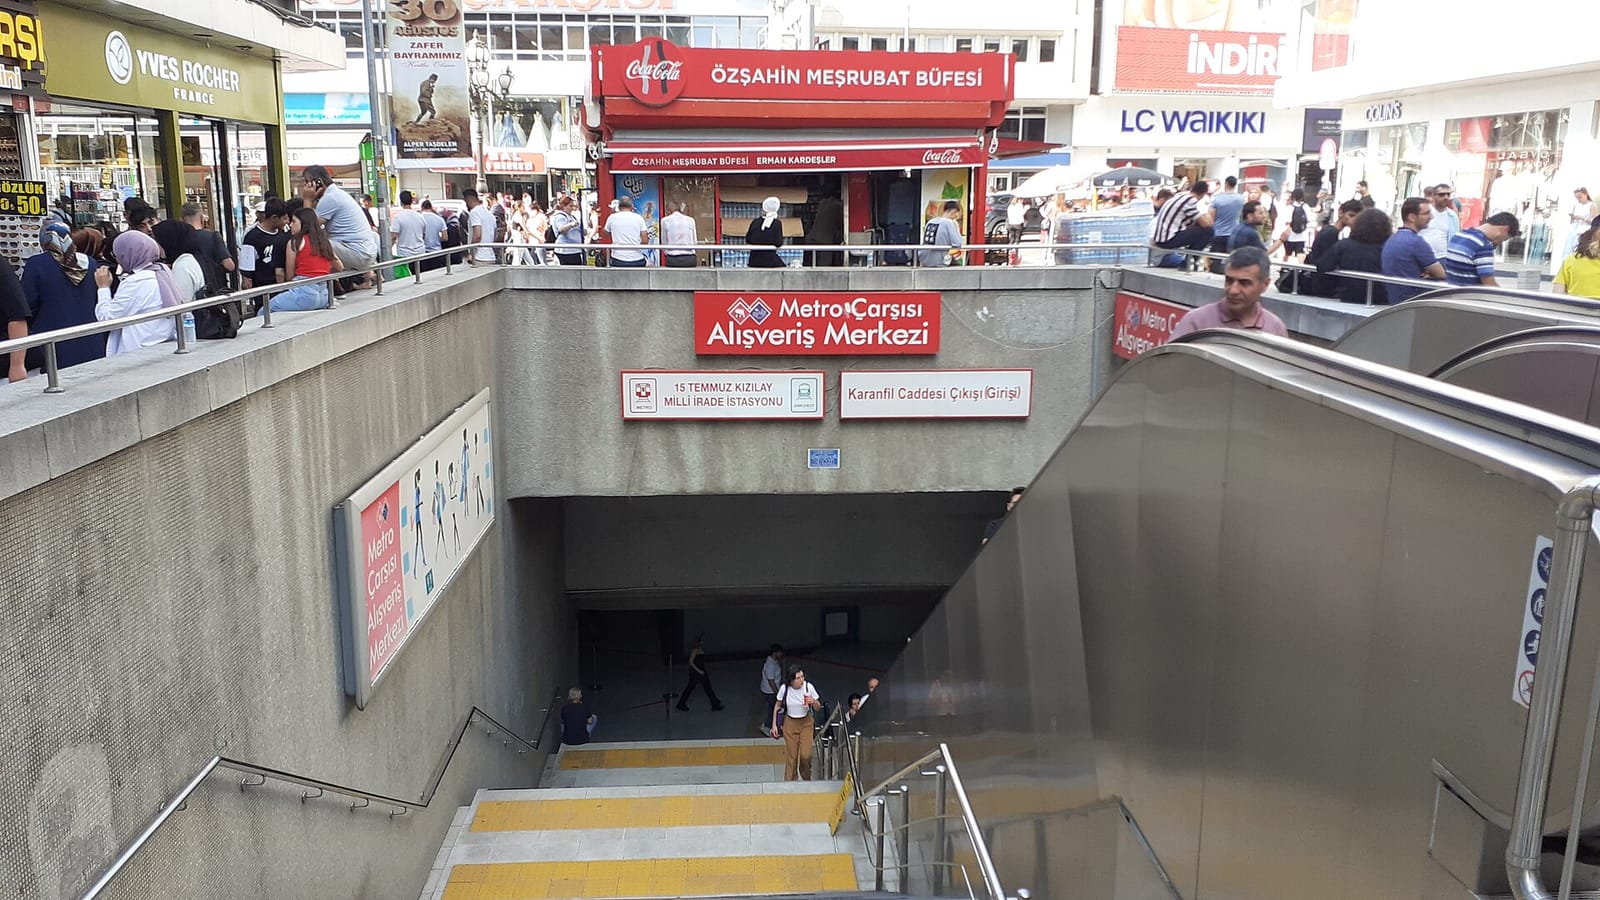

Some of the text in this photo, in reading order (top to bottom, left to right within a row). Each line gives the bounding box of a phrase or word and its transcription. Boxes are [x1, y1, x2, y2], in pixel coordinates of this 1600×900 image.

[389, 0, 458, 21] 30
[394, 25, 459, 37] AĞUSTOS
[136, 49, 240, 92] YVES ROCHER
[711, 64, 983, 88] ÖZŞAHİN MEŞRUBAT BÜFESİ
[173, 87, 215, 105] FRANCE
[1121, 110, 1155, 132] LC
[632, 156, 836, 166] ÖZŞAHİN MEŞRUBAT BÜFESİ ERMAN KARDEŞLER
[0, 180, 45, 194] ÖZLÜK
[780, 297, 923, 321] Metro Çarşısı
[1141, 306, 1166, 332] Metro
[706, 321, 929, 350] Alışveriş Merkezi
[674, 382, 774, 393] 15 TEMMUZ KIZILAY
[848, 387, 895, 400] Karanfil
[898, 386, 947, 400] Caddesi
[950, 387, 983, 402] Çıkışı
[693, 394, 725, 407] İRADE
[726, 394, 783, 407] İSTASYONU
[367, 527, 395, 567] Metro
[367, 553, 398, 600] Çarşısı
[367, 580, 403, 635] Alışveriş
[368, 607, 405, 669] Merkezi
